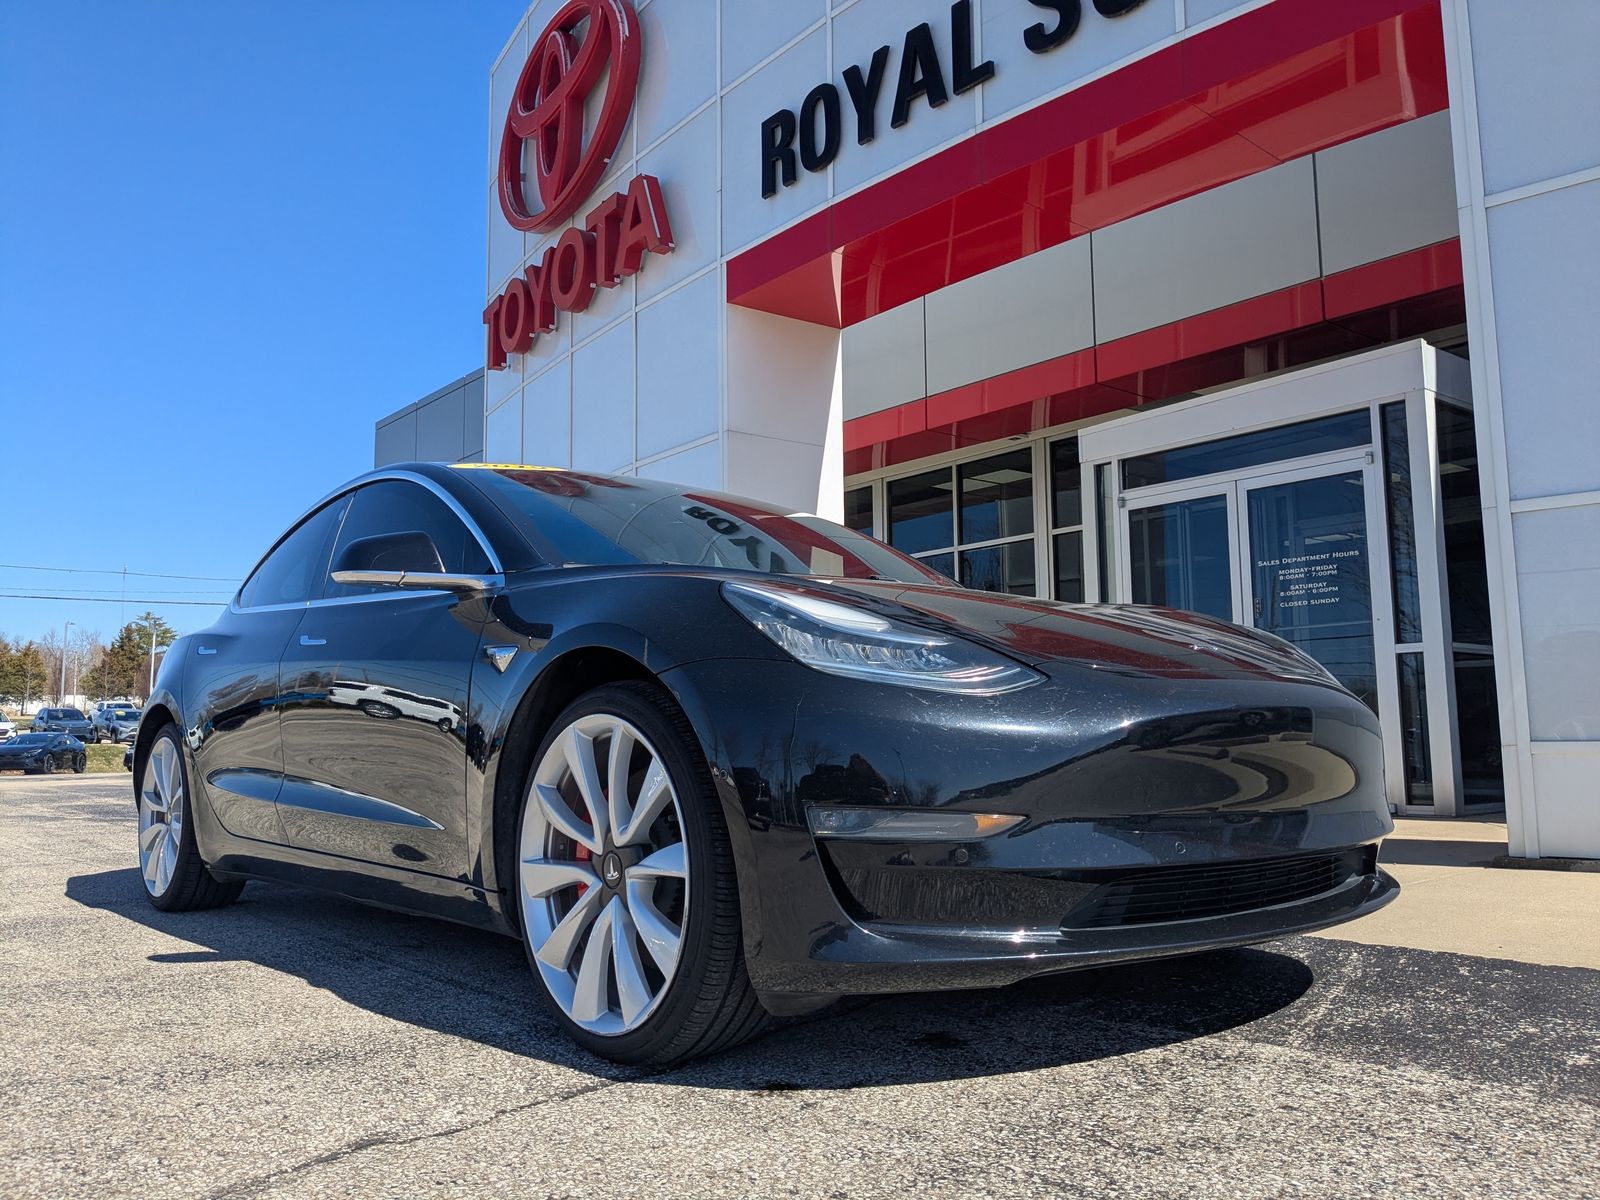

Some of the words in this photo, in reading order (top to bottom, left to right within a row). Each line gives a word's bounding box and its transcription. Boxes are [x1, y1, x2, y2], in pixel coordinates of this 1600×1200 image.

[761, 0, 995, 200] ROYAL
[483, 173, 674, 371] TOYOTA
[1279, 564, 1338, 575] MONDAY-FRIDAY
[1311, 569, 1338, 577] 7:00PM
[1290, 582, 1328, 590] SATURDAY
[1312, 586, 1339, 594] 6:00PM
[1280, 600, 1308, 608] CLOSED
[1310, 597, 1340, 605] SUNDAY
